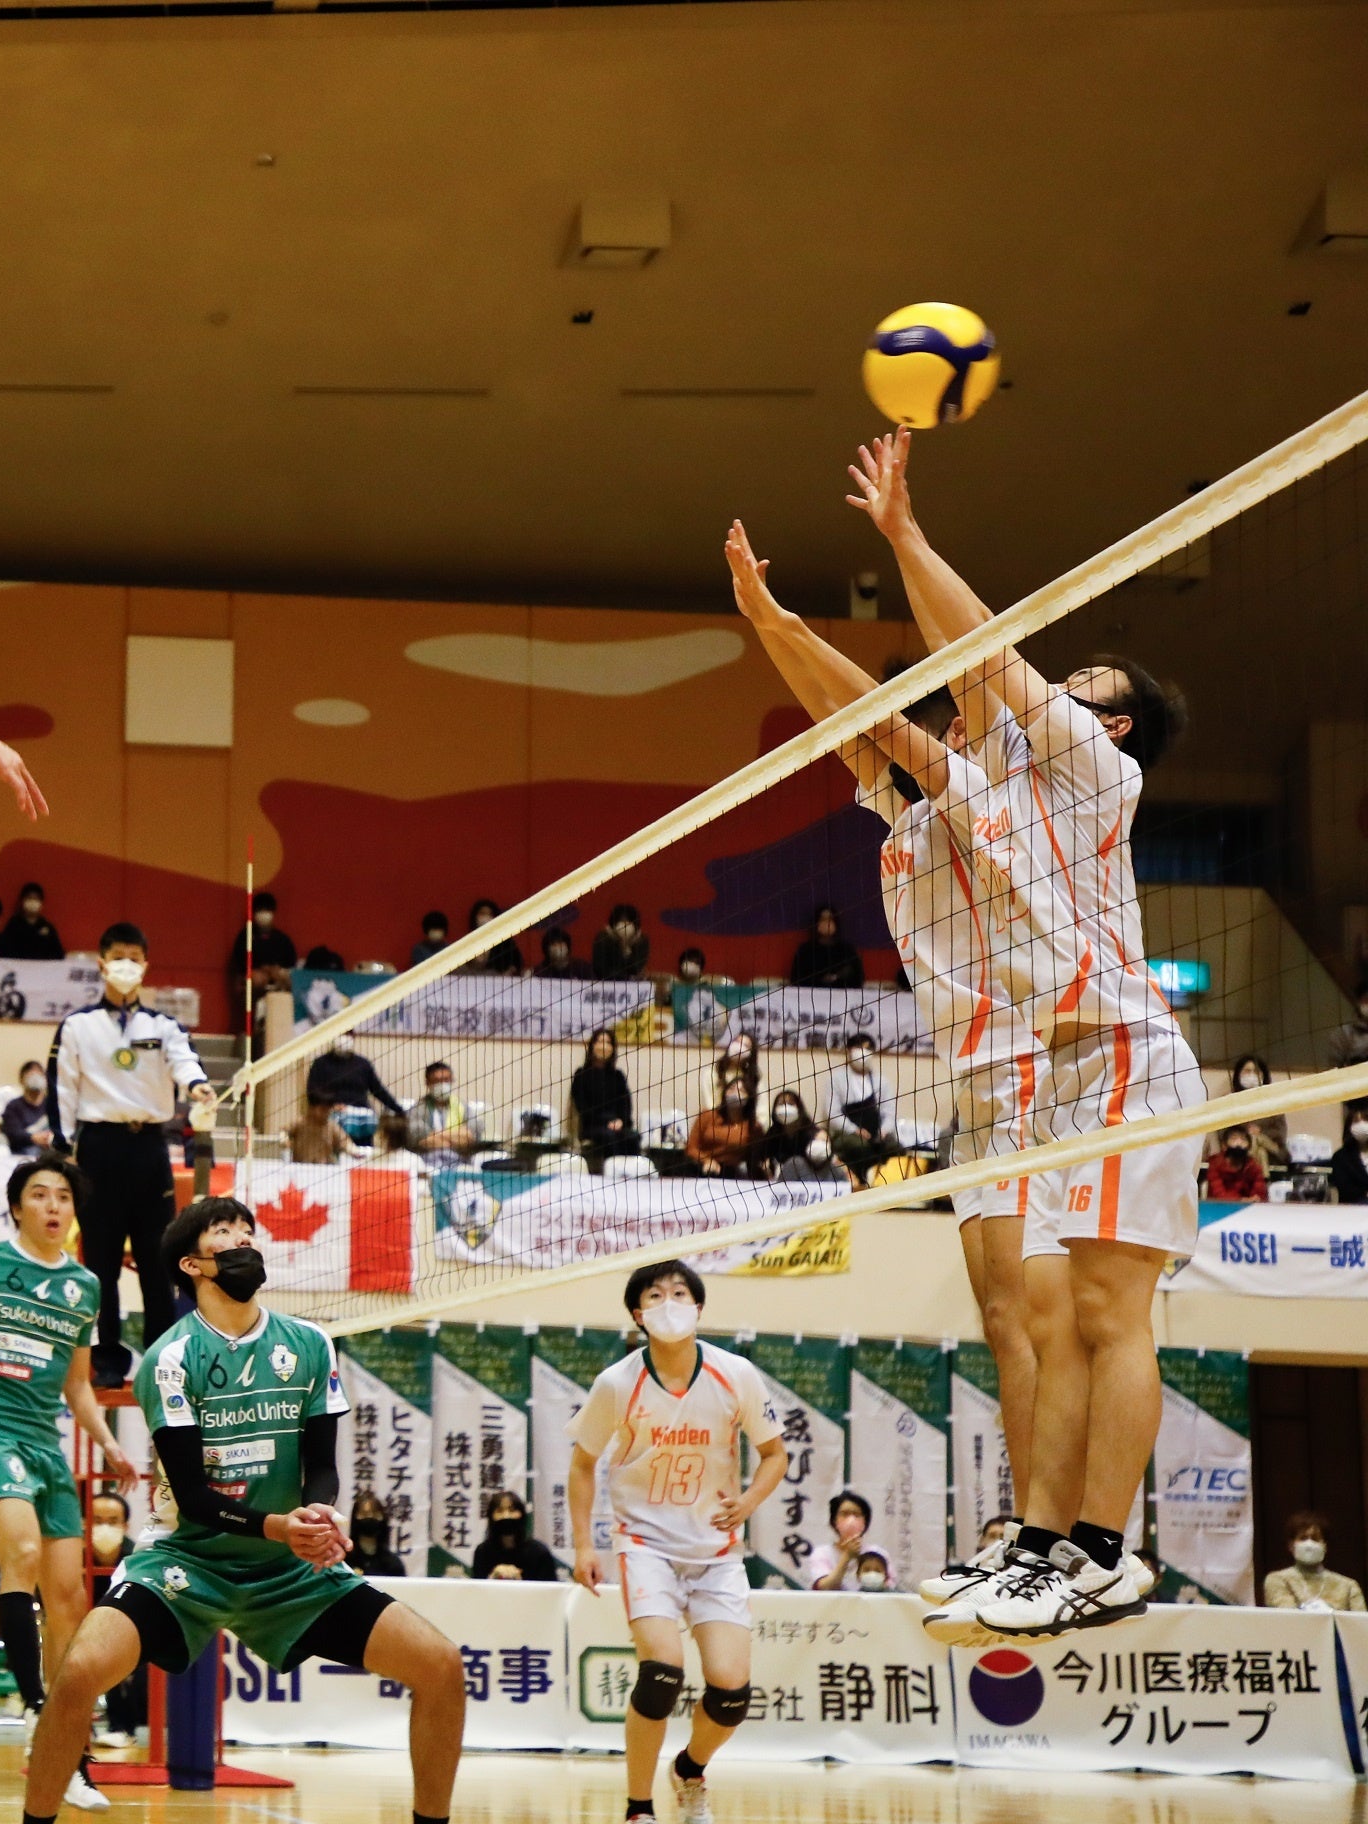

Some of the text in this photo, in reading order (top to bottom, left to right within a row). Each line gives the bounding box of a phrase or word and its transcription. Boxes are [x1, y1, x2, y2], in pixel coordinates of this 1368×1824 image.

[1067, 1184, 1094, 1213] 16
[751, 1253, 783, 1268] Sun
[1220, 1231, 1278, 1265] ISSEI
[6, 1267, 25, 1292] 6
[257, 1400, 304, 1421] Unite
[650, 1422, 711, 1447] Kinden
[443, 1431, 472, 1549] 株式会社
[647, 1452, 706, 1506] 13
[1052, 1649, 1321, 1696] 今川医療福祉
[818, 1661, 940, 1726] 静科
[1101, 1701, 1278, 1747] グループ
